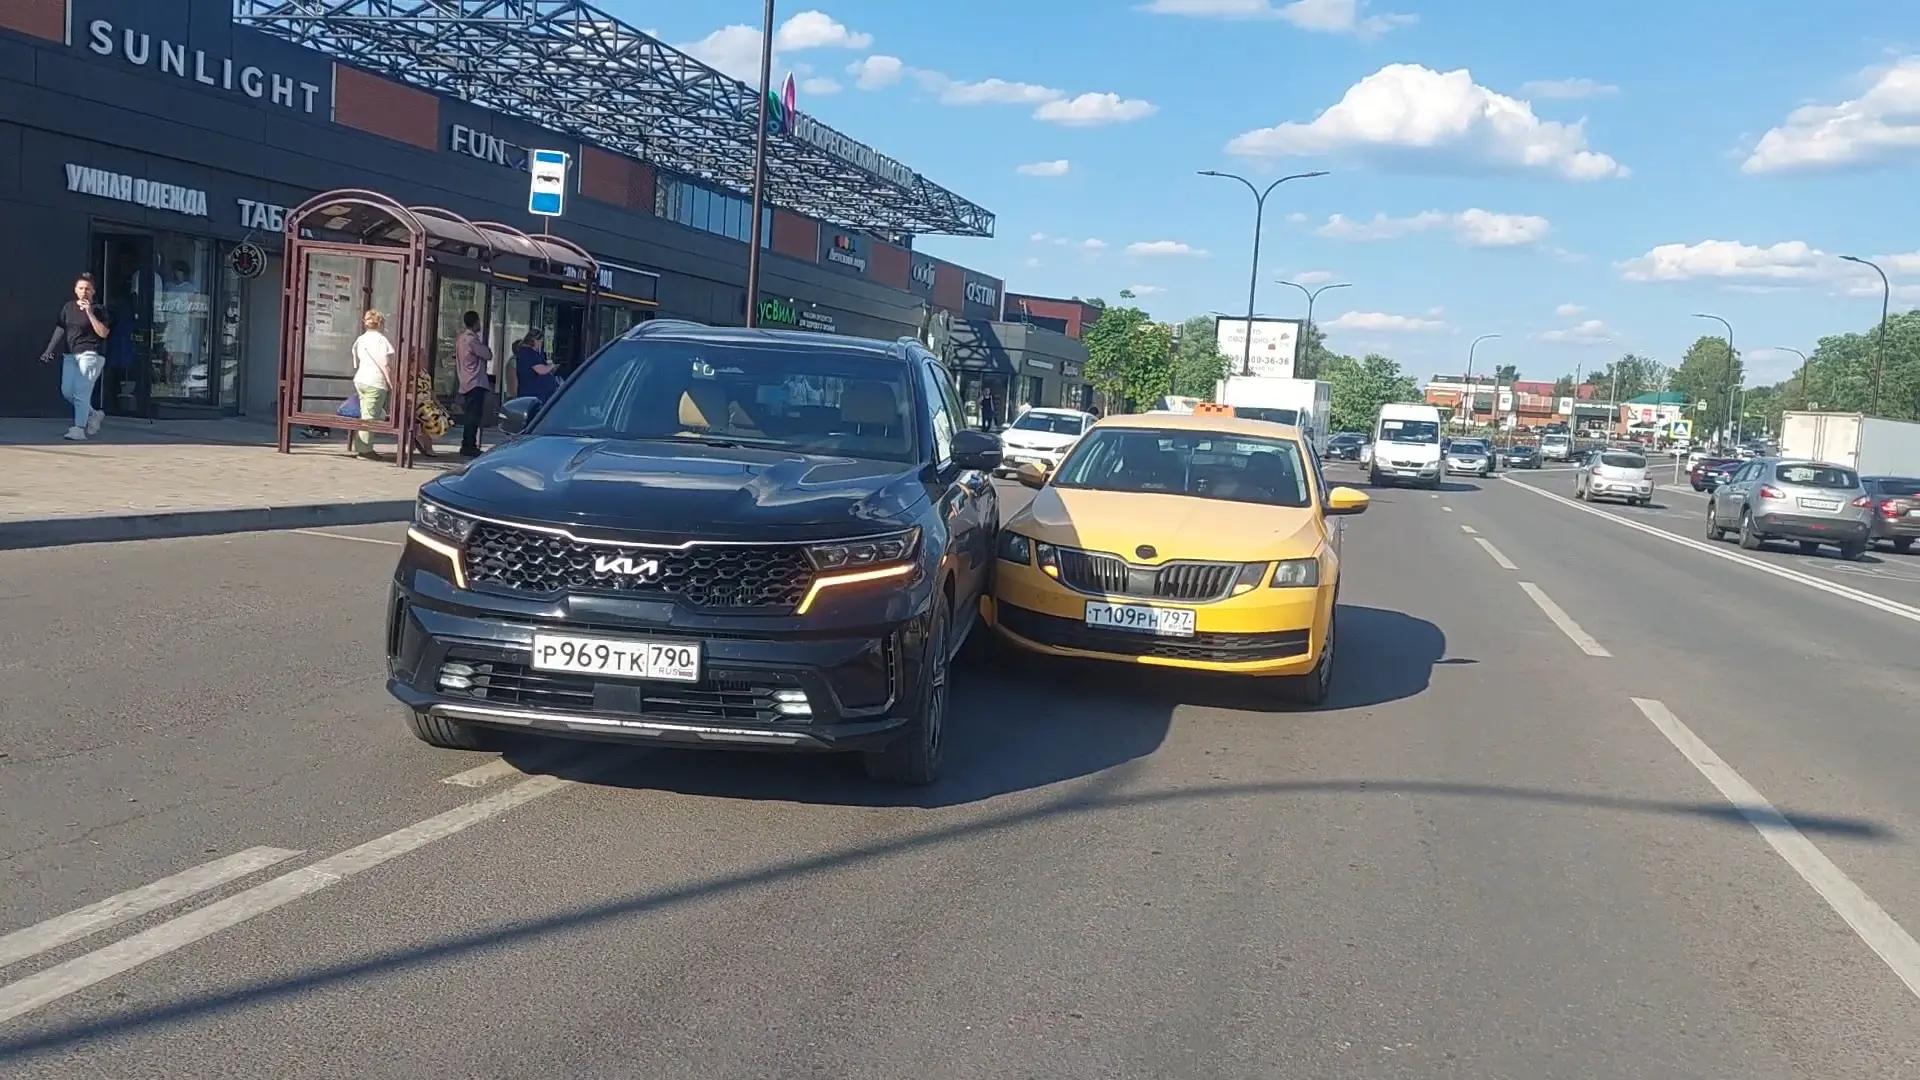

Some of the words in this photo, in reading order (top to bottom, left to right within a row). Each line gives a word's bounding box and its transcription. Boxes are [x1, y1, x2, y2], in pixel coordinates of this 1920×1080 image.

[89, 19, 320, 113] SUNLIGHT
[451, 123, 505, 165] FUN
[65, 163, 133, 202] УМНАЯ
[133, 177, 208, 217] ОДЕЖДА
[237, 199, 313, 238] ТАБ
[1163, 610, 1190, 626] 797
[651, 646, 691, 667] 790
[658, 667, 680, 676] RUS
